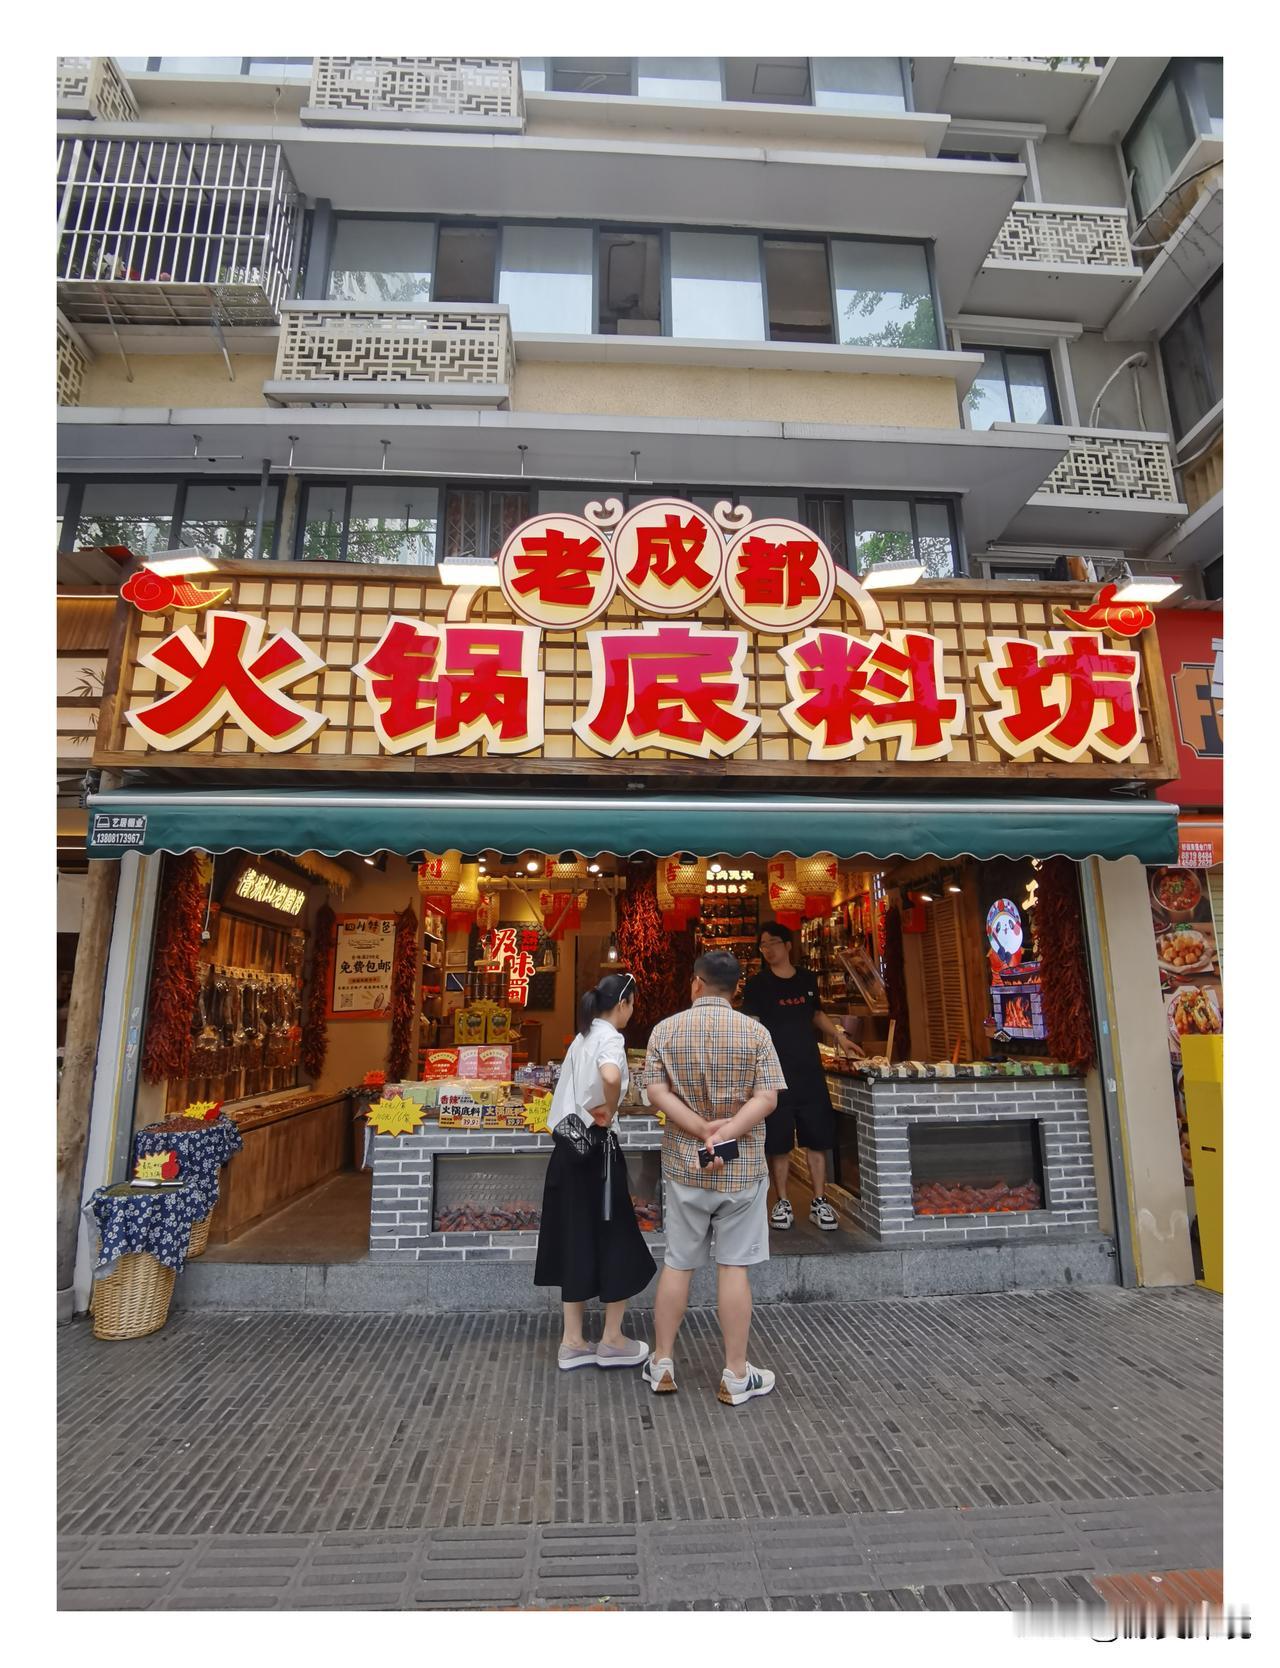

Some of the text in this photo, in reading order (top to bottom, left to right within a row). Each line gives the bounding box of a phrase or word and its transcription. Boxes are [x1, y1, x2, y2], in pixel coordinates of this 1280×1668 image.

[509, 513, 822, 610] 老成都
[136, 616, 1140, 748] 火锅底料坊
[97, 833, 140, 844] 13808173967
[344, 919, 393, 934] 四川特色
[339, 960, 391, 975] 免费包邮
[441, 1106, 480, 1117] 火锅底料
